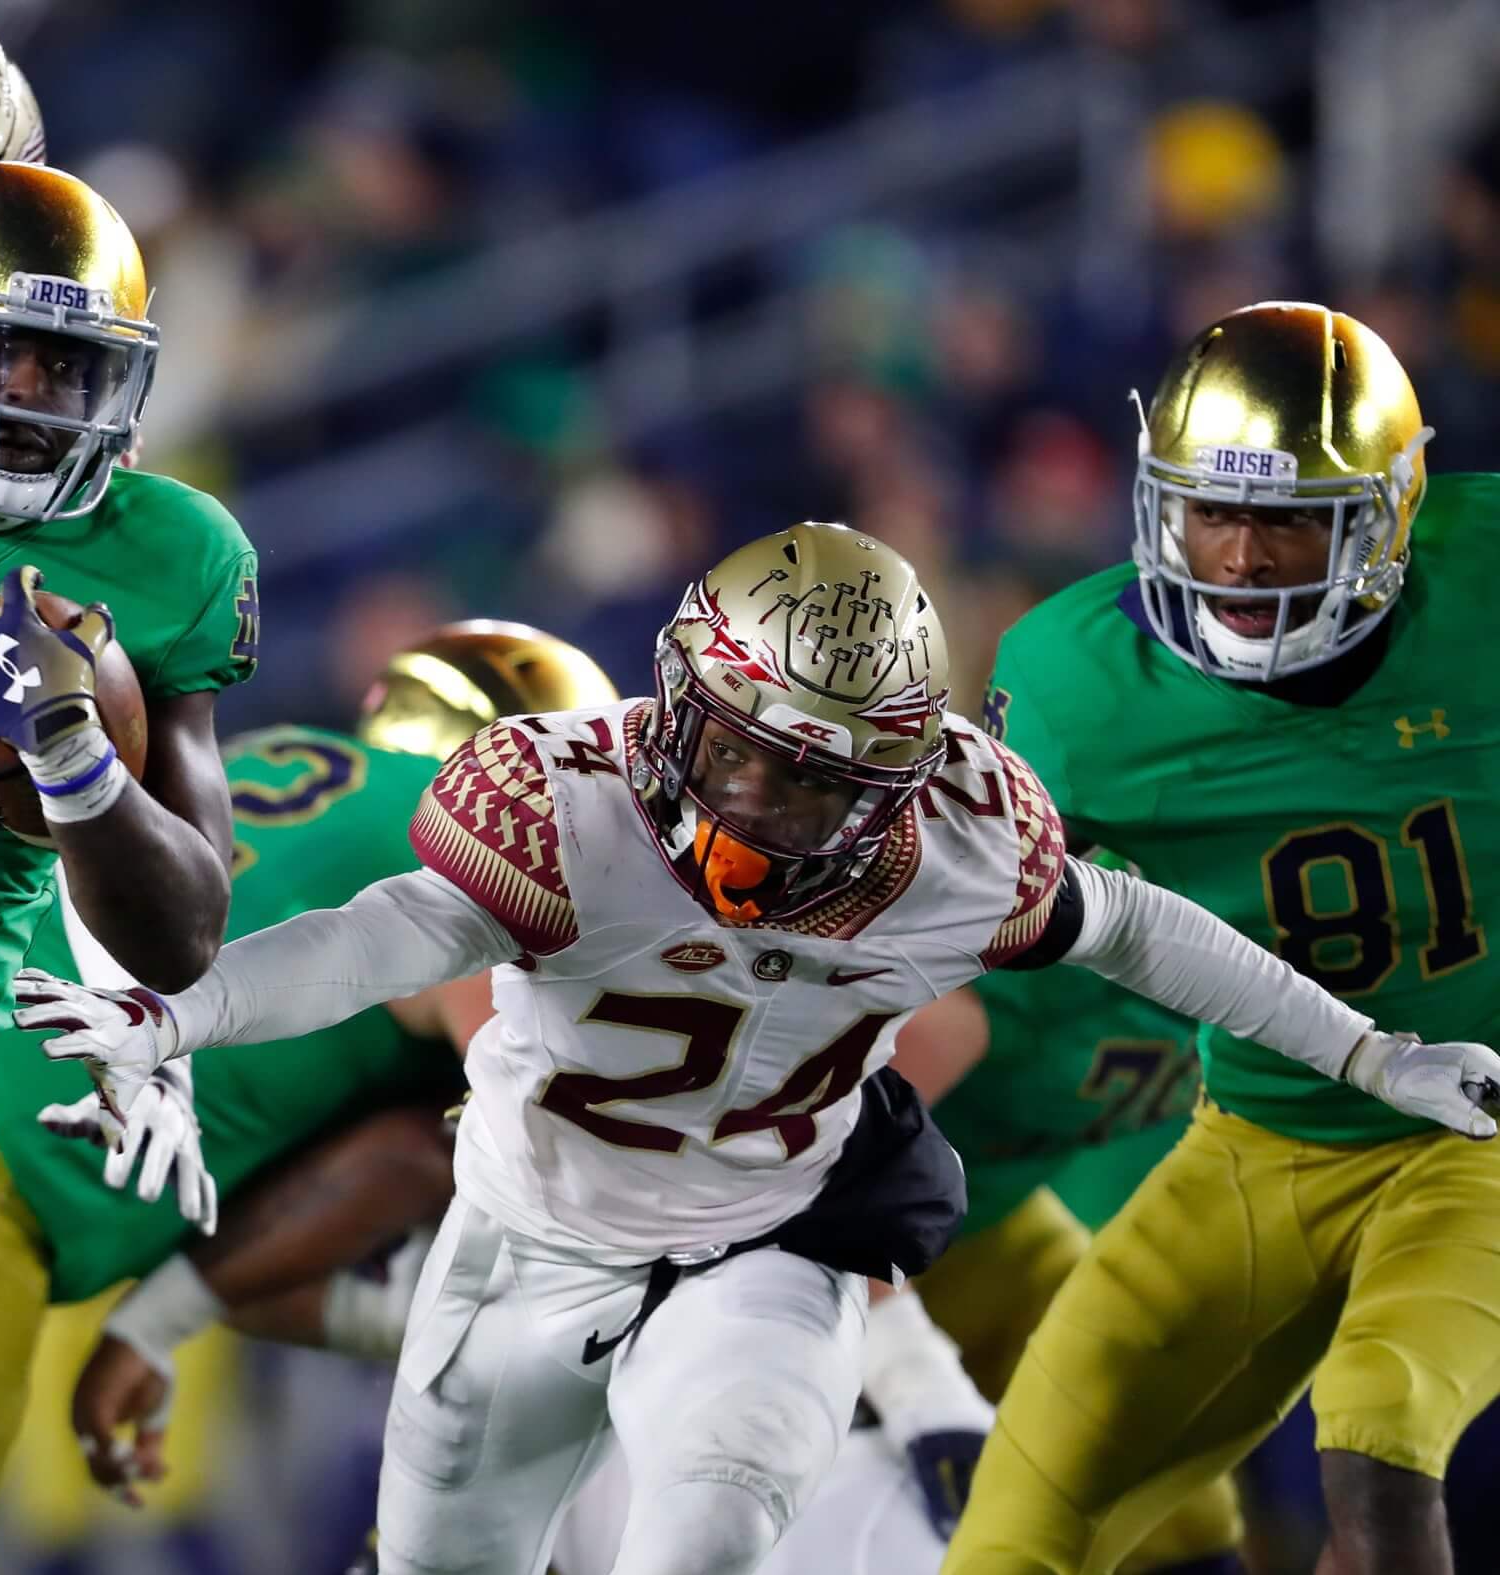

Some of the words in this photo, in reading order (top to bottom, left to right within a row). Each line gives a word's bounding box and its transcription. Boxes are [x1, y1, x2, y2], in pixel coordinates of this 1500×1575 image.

[31, 280, 88, 310] IRISH
[1215, 449, 1273, 477] IRISH
[787, 721, 838, 743] ACC
[1260, 797, 1489, 999] 81
[536, 986, 904, 1163] 24
